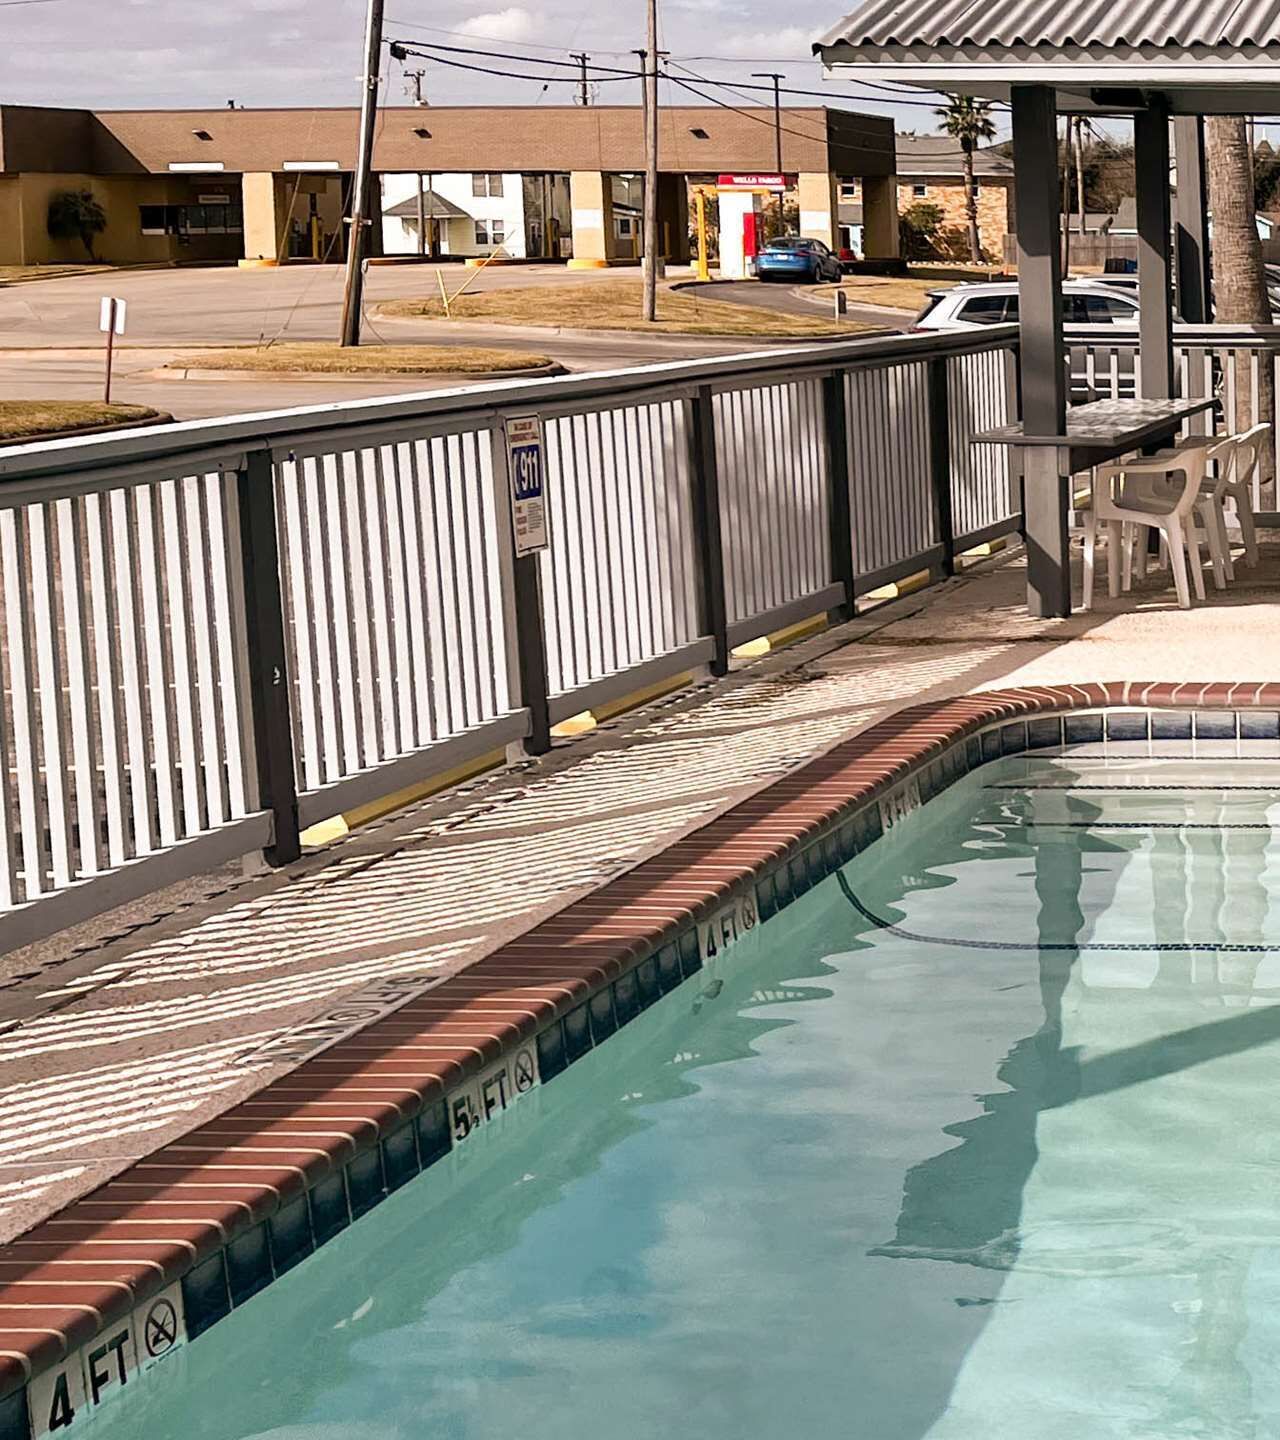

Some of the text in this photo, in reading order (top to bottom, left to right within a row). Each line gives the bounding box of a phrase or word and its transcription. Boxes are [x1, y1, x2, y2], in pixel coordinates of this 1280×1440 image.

[520, 450, 540, 491] 911
[706, 908, 738, 957] 4 FT
[481, 1068, 507, 1121] FT
[48, 1328, 129, 1432] 4 FT
